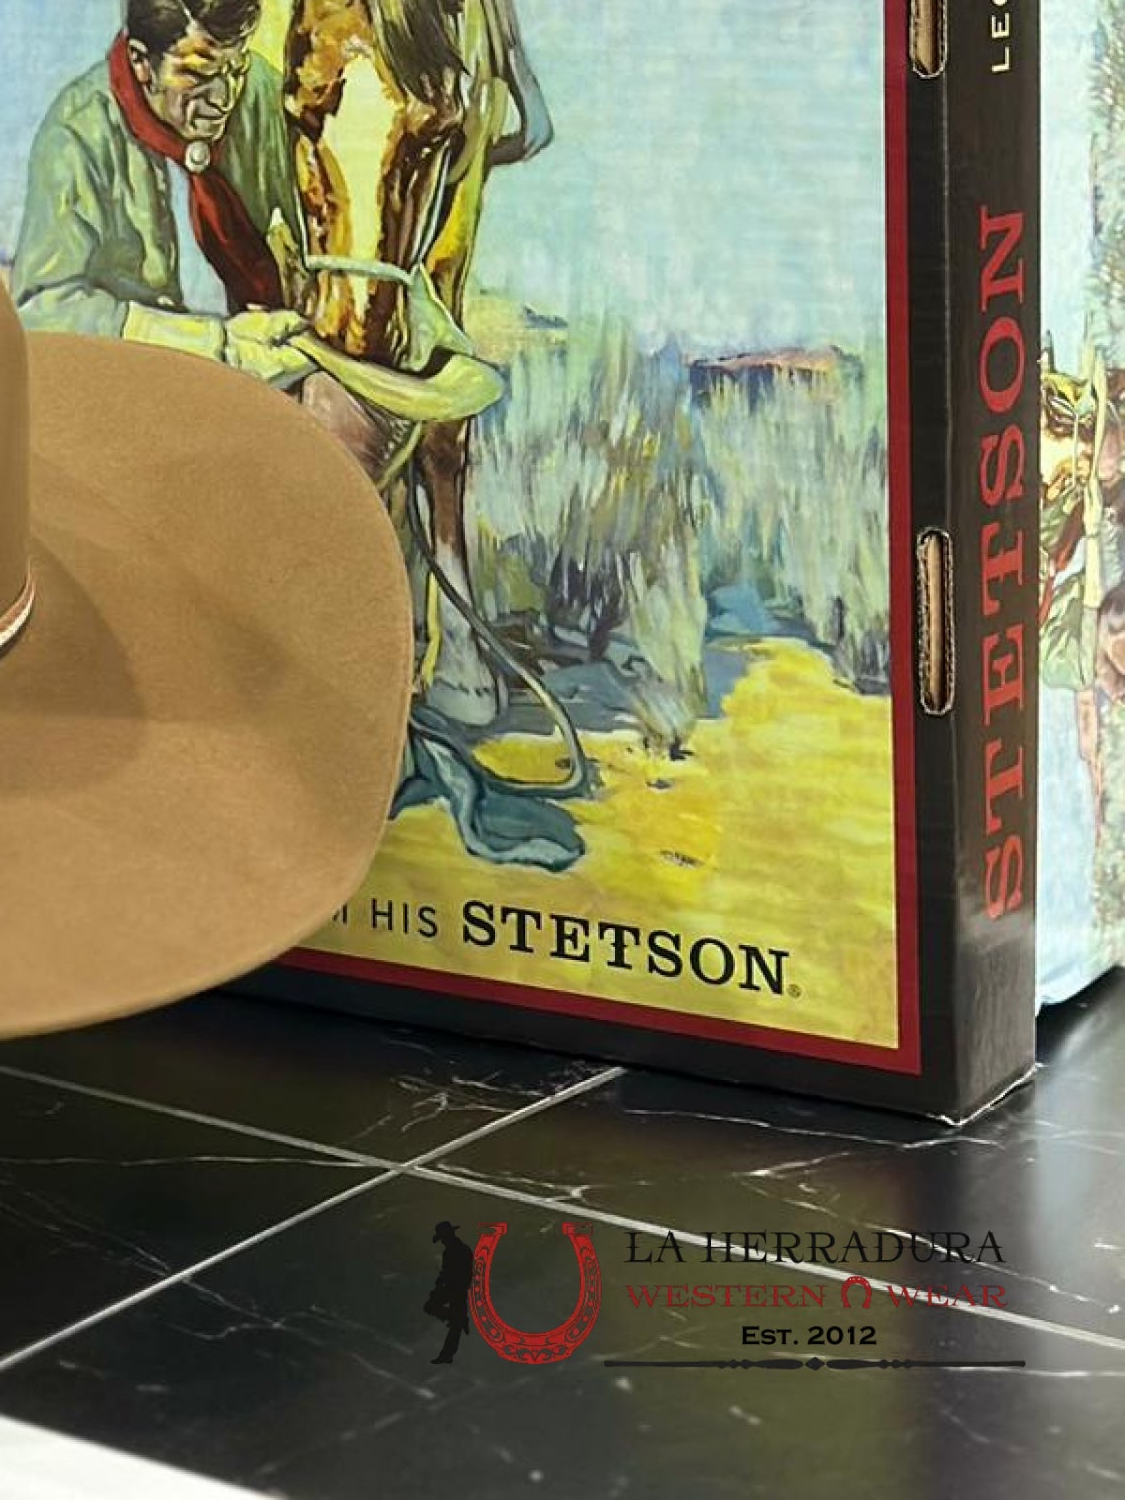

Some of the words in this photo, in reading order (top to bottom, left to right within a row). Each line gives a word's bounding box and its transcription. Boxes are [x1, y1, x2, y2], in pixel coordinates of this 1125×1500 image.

[978, 205, 1026, 919] STETSON
[370, 897, 439, 938] HIS
[461, 900, 791, 995] STETSON
